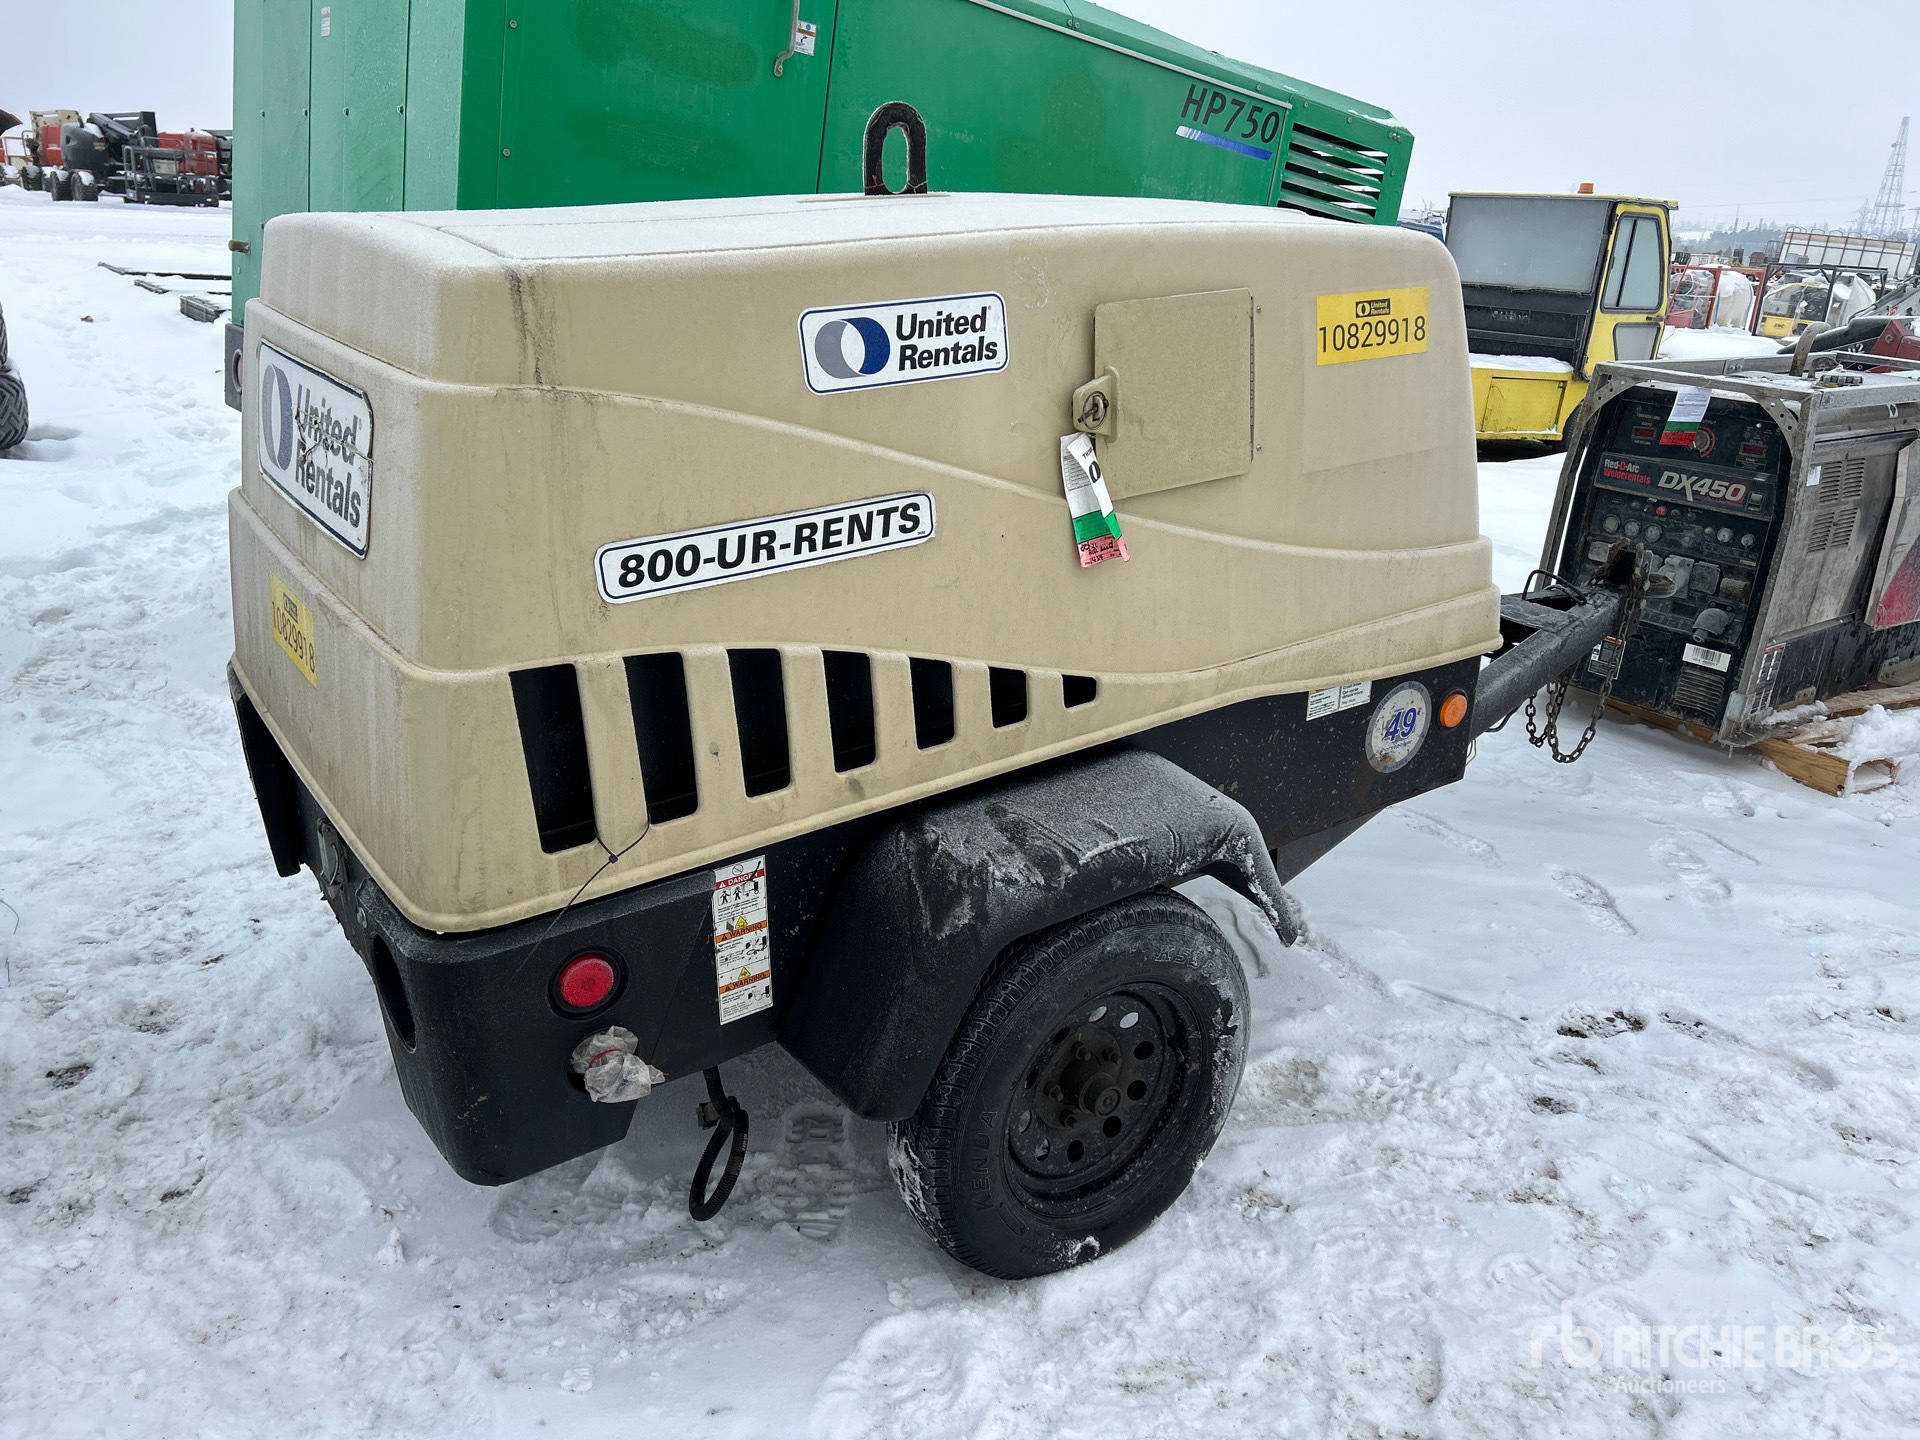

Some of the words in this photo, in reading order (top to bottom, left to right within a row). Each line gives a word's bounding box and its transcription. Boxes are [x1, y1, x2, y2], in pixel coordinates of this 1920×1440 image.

[1180, 83, 1280, 144] HP750
[896, 306, 988, 341] United
[1318, 315, 1426, 353] 10829918
[898, 335, 998, 372] Rentals
[296, 383, 359, 466] United
[295, 437, 361, 528] Rentals
[1603, 458, 1640, 473] Red-D-Arc
[1603, 467, 1652, 485] Welderentals
[1657, 470, 1747, 503] DX450
[617, 502, 921, 589] 800-UR-RENTS
[271, 600, 316, 674] 10829918
[1407, 681, 1425, 694] Series
[1384, 707, 1418, 742] 49
[1382, 757, 1408, 772] Warranty
[729, 922, 763, 938] WARNING
